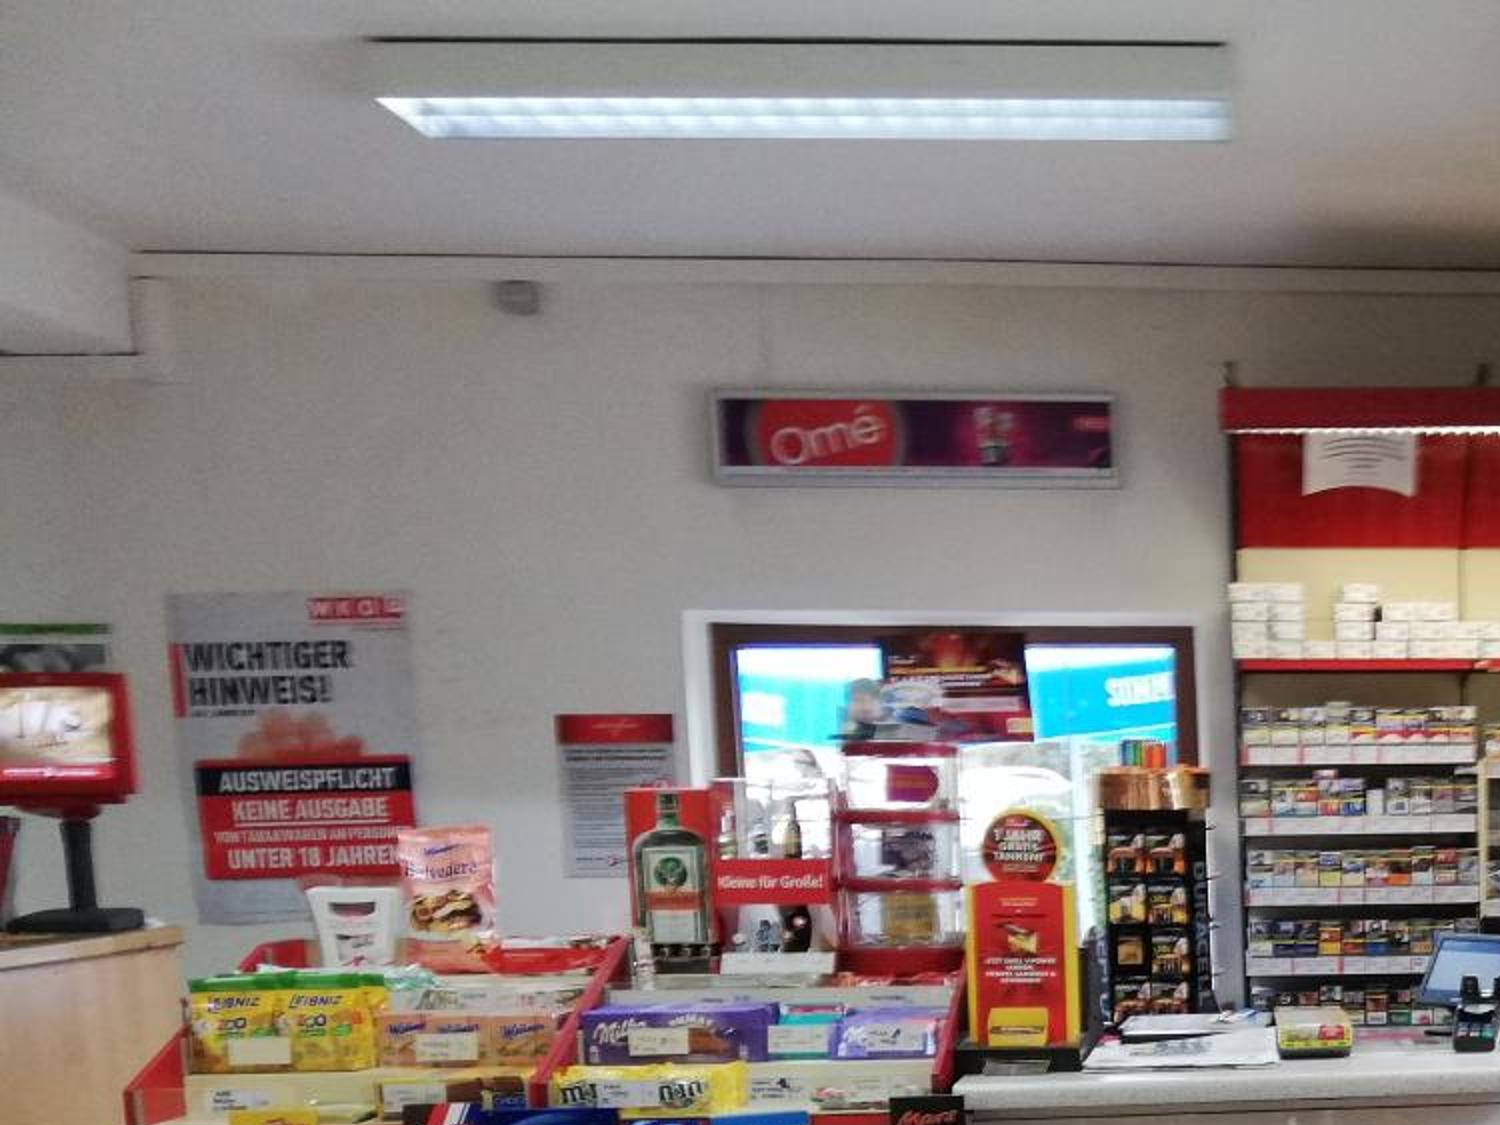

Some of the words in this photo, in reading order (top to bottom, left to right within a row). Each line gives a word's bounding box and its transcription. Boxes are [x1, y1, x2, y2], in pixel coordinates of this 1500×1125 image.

[185, 640, 351, 671] WICHTIGER
[188, 675, 333, 706] HINWEIS!
[219, 767, 395, 793] AUSWEISPFLICHT
[232, 801, 290, 821] KEINE
[296, 798, 389, 819] AUSGABE
[227, 848, 297, 870] UNTER
[301, 847, 322, 868] 18
[759, 874, 778, 889] für
[780, 874, 824, 889] Große!
[288, 994, 344, 1010] LEIBNIZ
